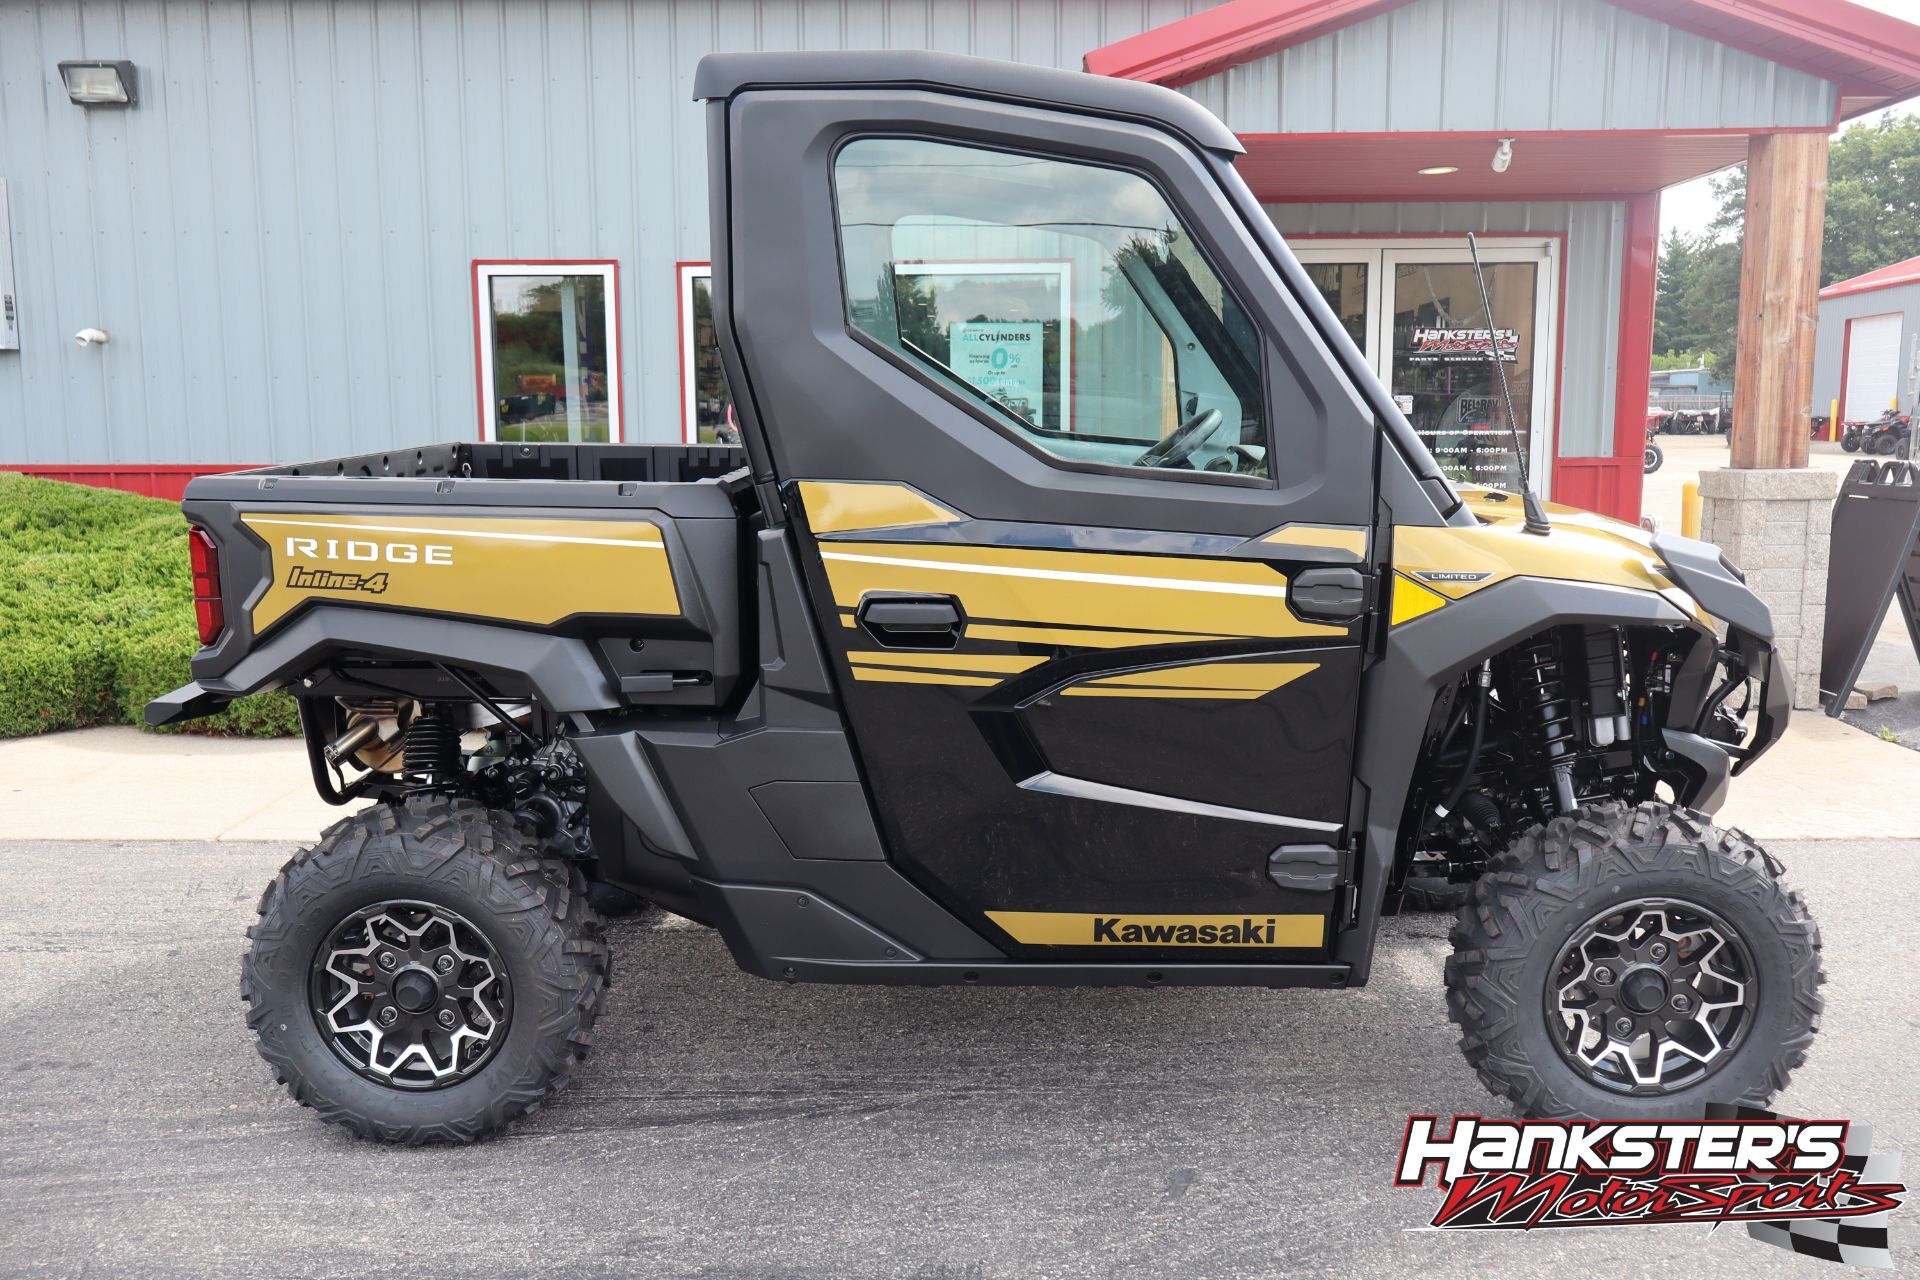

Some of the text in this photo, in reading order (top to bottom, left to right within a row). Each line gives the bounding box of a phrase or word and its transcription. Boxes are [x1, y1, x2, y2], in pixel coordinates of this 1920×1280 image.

[286, 537, 454, 566] RIDGE
[286, 566, 389, 594] Inline-4
[1094, 918, 1276, 944] Kawasaki
